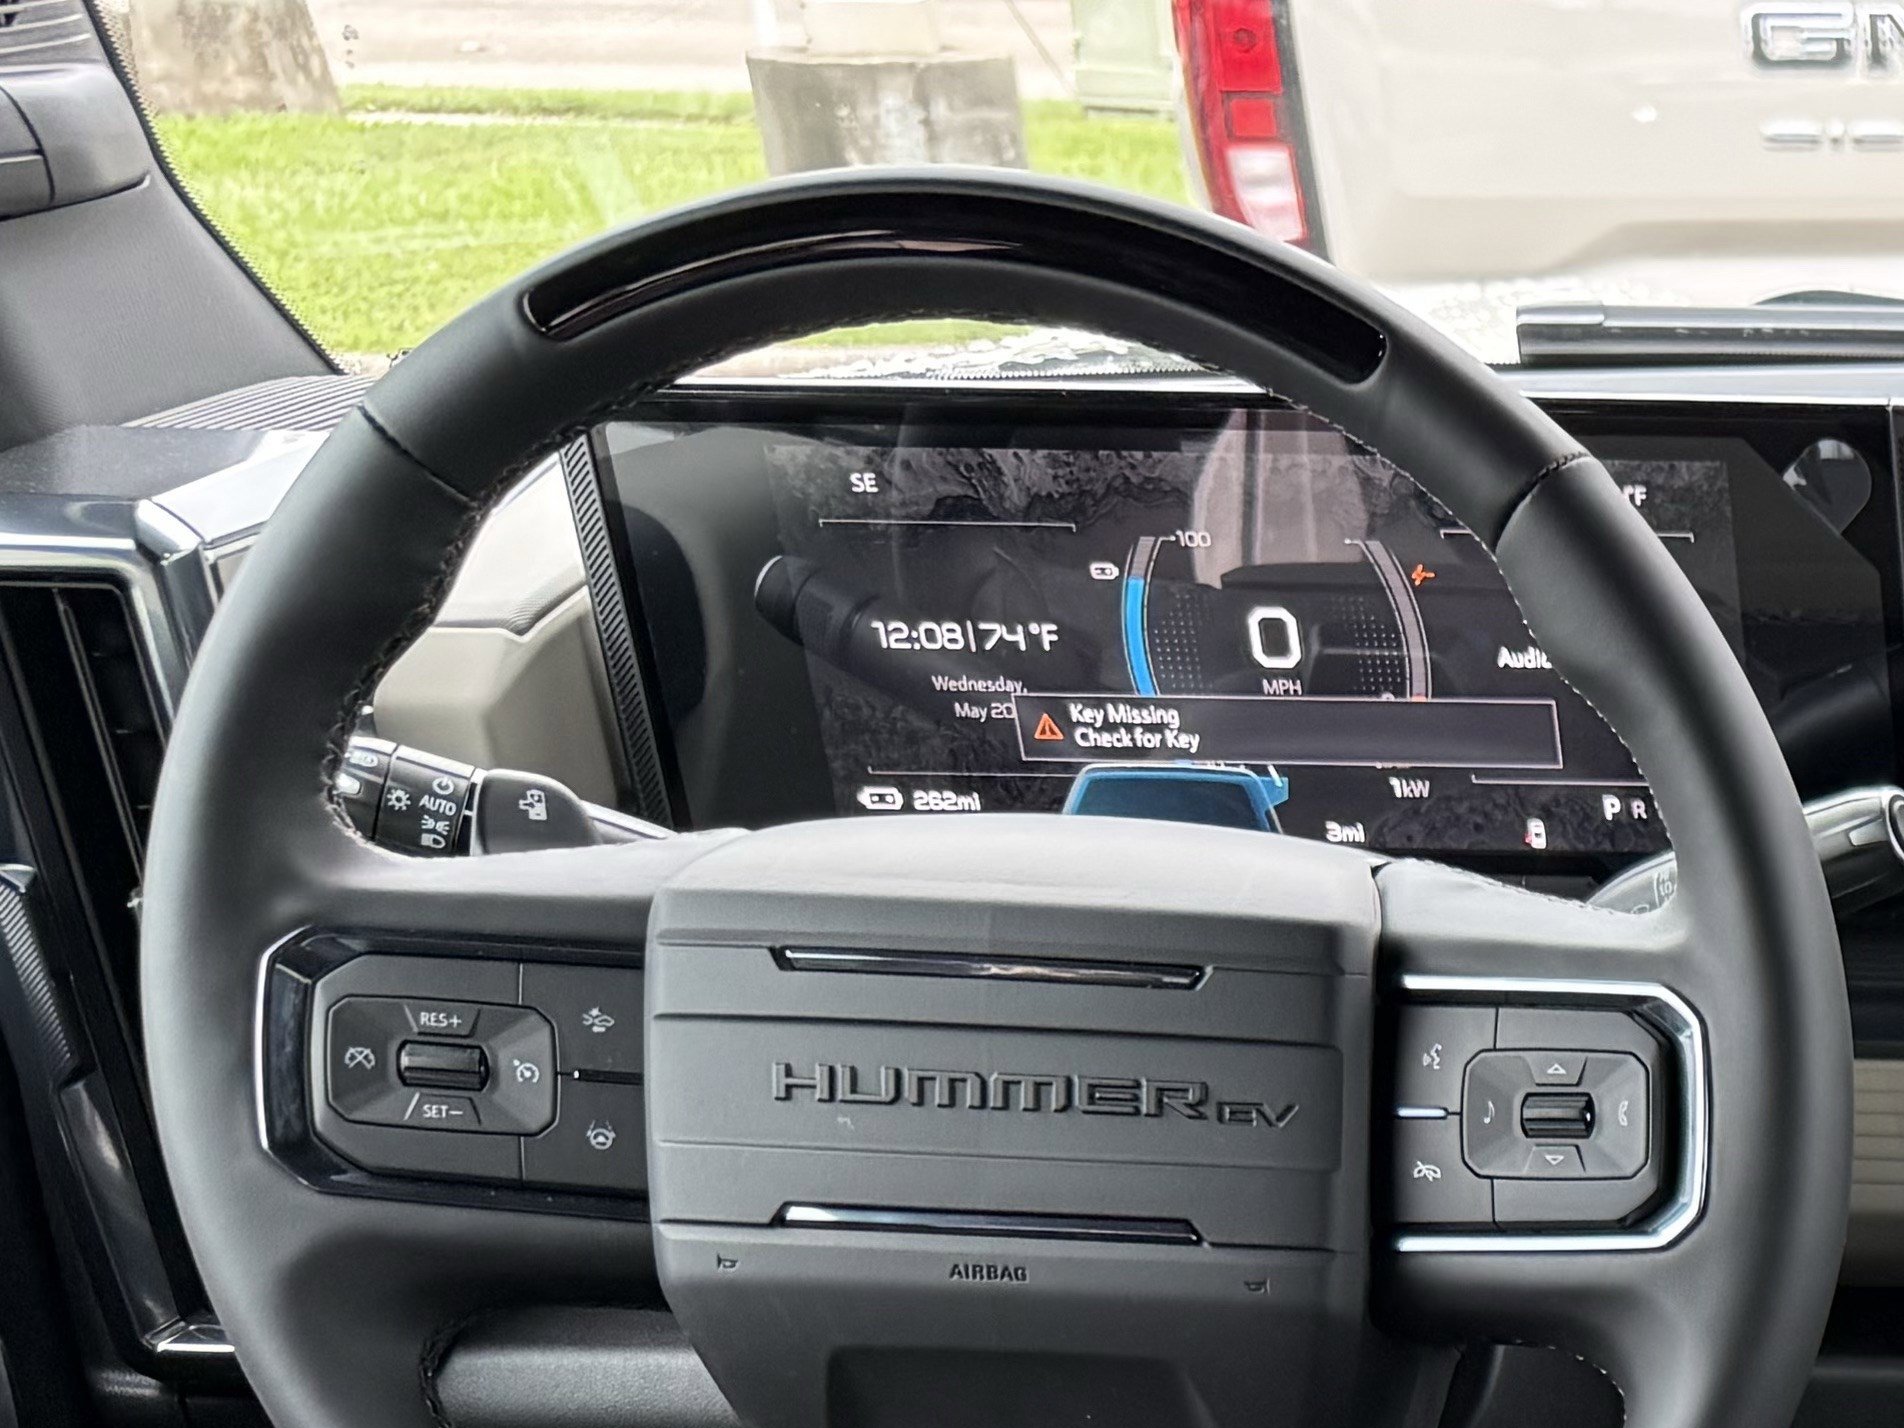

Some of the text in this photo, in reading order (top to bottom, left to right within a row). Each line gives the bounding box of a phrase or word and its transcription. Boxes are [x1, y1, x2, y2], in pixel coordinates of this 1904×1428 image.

[850, 473, 878, 492] SE
[1175, 530, 1211, 548] 100
[1247, 607, 1301, 668] 0
[931, 674, 1028, 694] Wednesday,
[1262, 679, 1302, 696] MPH
[954, 702, 988, 723] May
[1069, 703, 1182, 730] Key Missing
[1074, 731, 1202, 754] Check for Key
[1388, 776, 1431, 799] 1kW
[419, 795, 457, 817] AUTO
[1602, 794, 1648, 820] P R
[1325, 821, 1366, 843] 3mi
[771, 1061, 1300, 1128] HUMMER EV
[949, 1261, 1027, 1283] AIRBAG
